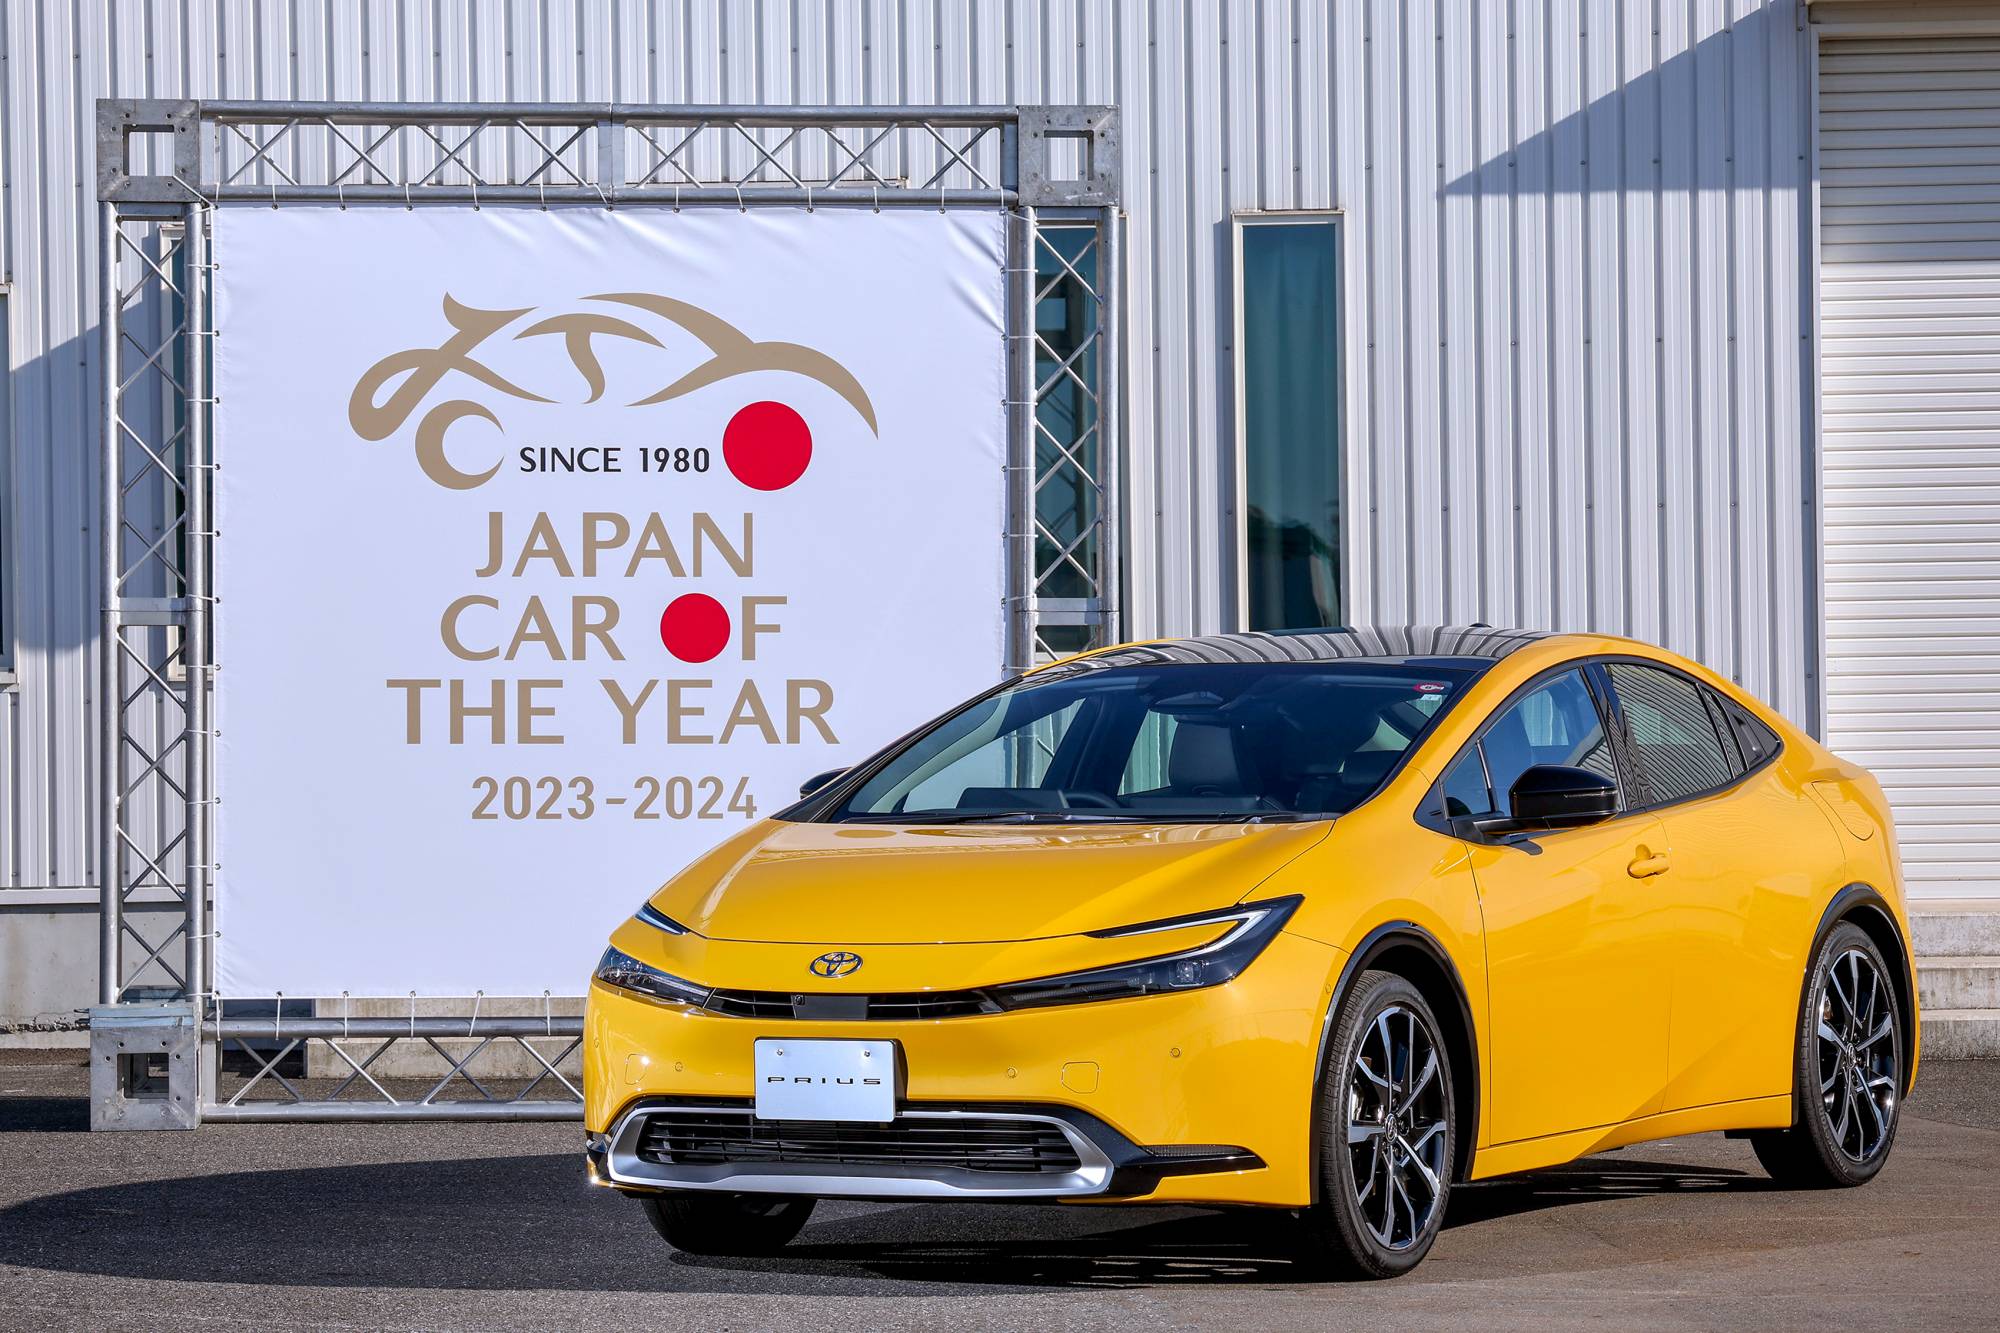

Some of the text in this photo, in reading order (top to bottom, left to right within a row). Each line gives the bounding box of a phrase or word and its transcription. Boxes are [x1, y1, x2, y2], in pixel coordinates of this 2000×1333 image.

[519, 446, 710, 473] SINCE 1980
[475, 511, 754, 578] JAPAN
[440, 593, 788, 663] CAR OF
[386, 678, 841, 745] THE YEAR
[471, 775, 758, 820] 2023-2024
[767, 1076, 881, 1085] PRIUS
